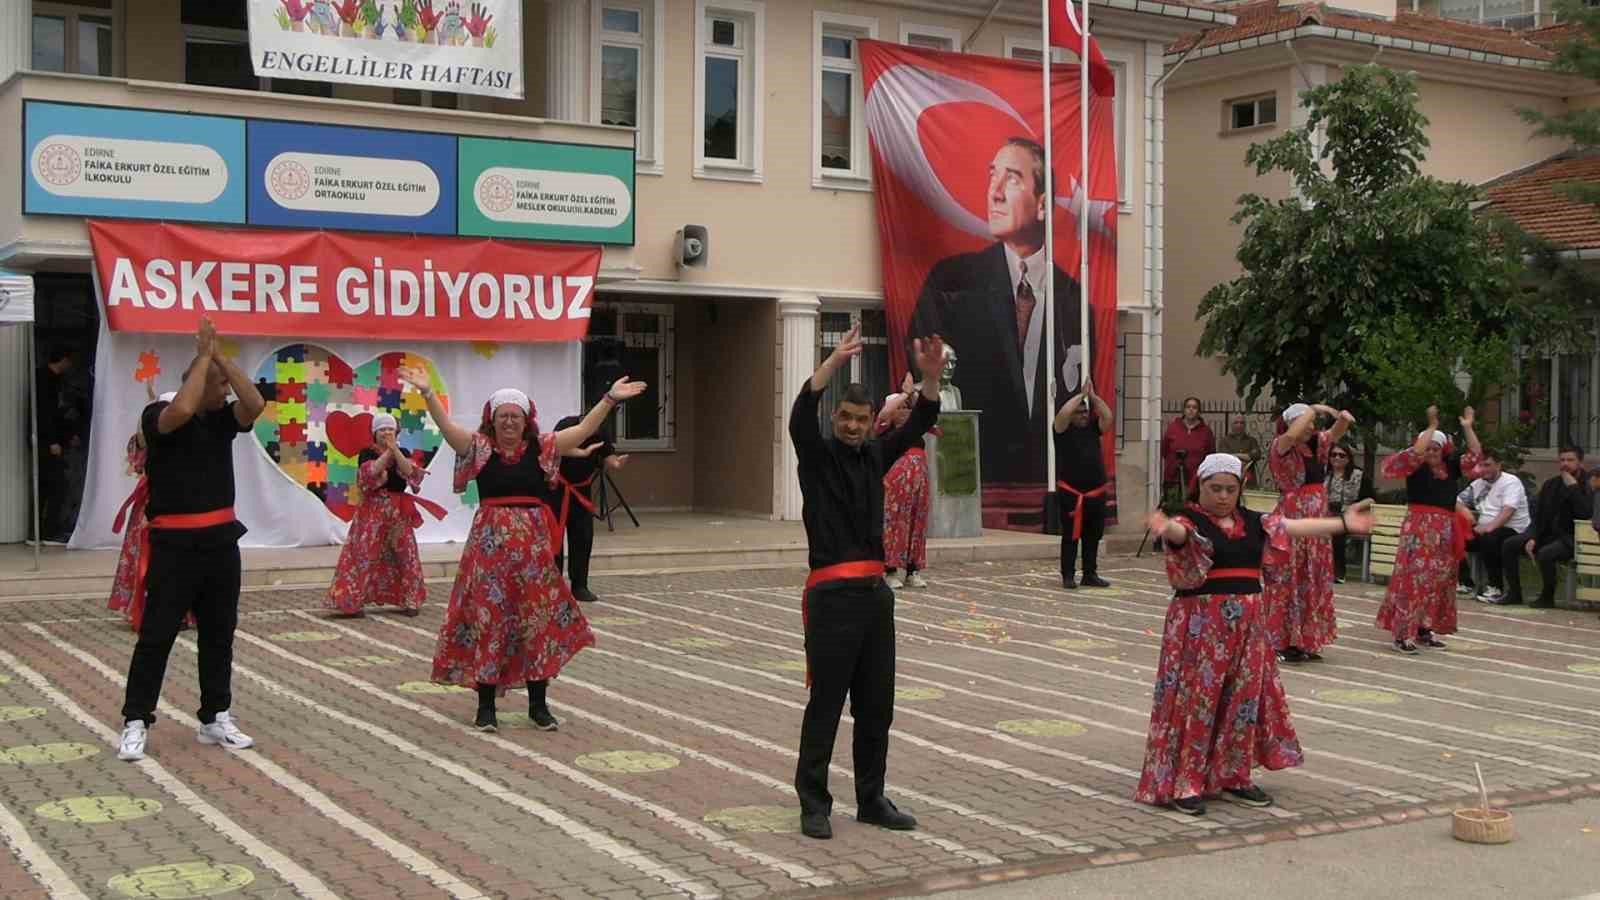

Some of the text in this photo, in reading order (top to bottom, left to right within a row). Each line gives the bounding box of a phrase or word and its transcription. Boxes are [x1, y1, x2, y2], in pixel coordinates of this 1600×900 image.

[262, 51, 512, 89] ENGELLİLER HAFTASI
[114, 161, 151, 173] ERKURT
[153, 163, 177, 175] ÖZEL
[178, 165, 210, 176] EĞİTİM
[84, 172, 132, 184] İLKOKULU
[341, 180, 373, 190] ERKURT
[375, 181, 396, 192] ÖZEL
[398, 182, 427, 193] EĞİTİM
[314, 191, 366, 201] ORTAOKULU
[540, 193, 569, 202] ERKURT
[570, 194, 589, 204] ÖZEL
[590, 195, 616, 204] EĞİTİM
[516, 202, 546, 211] MESLEK
[107, 257, 594, 321] ASKERE GİDİYORUZ
